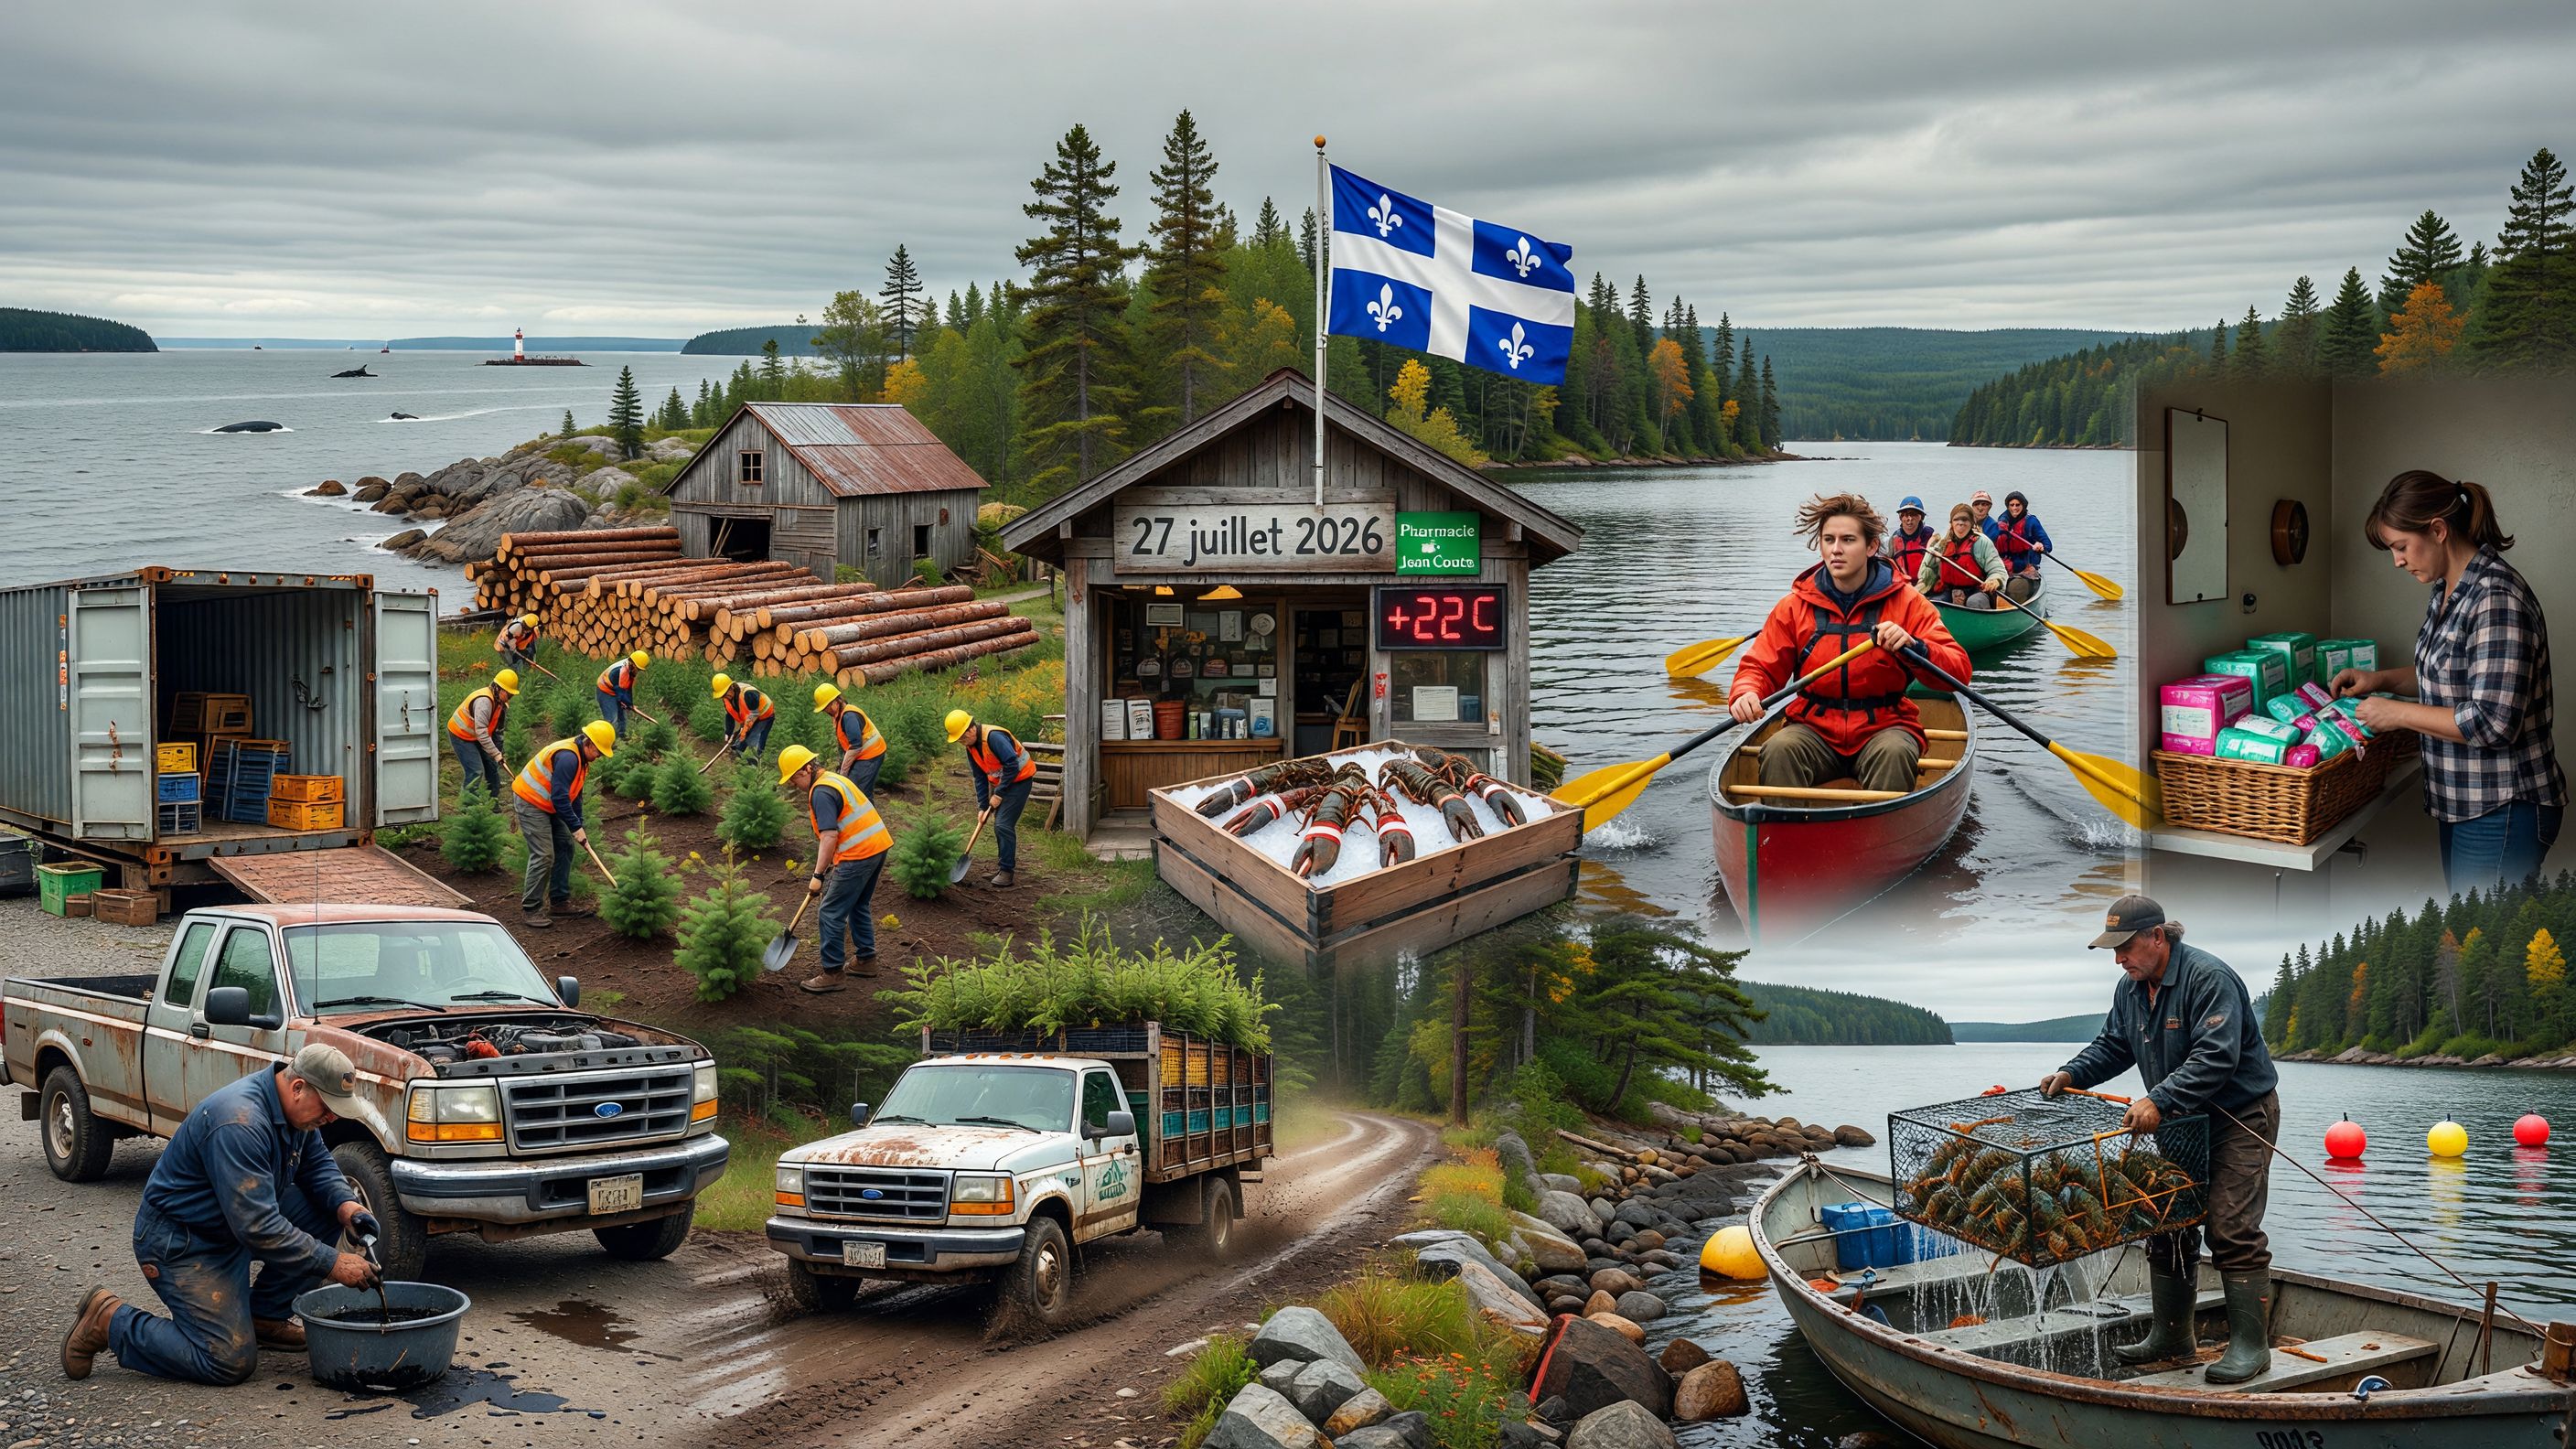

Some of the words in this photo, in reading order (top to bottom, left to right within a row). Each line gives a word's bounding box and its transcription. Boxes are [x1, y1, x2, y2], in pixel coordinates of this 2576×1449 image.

[1132, 517, 1175, 555] 27
[1183, 515, 1283, 567] juillet
[1295, 516, 1384, 555] 2026
[1400, 523, 1476, 538] Pharmacie
